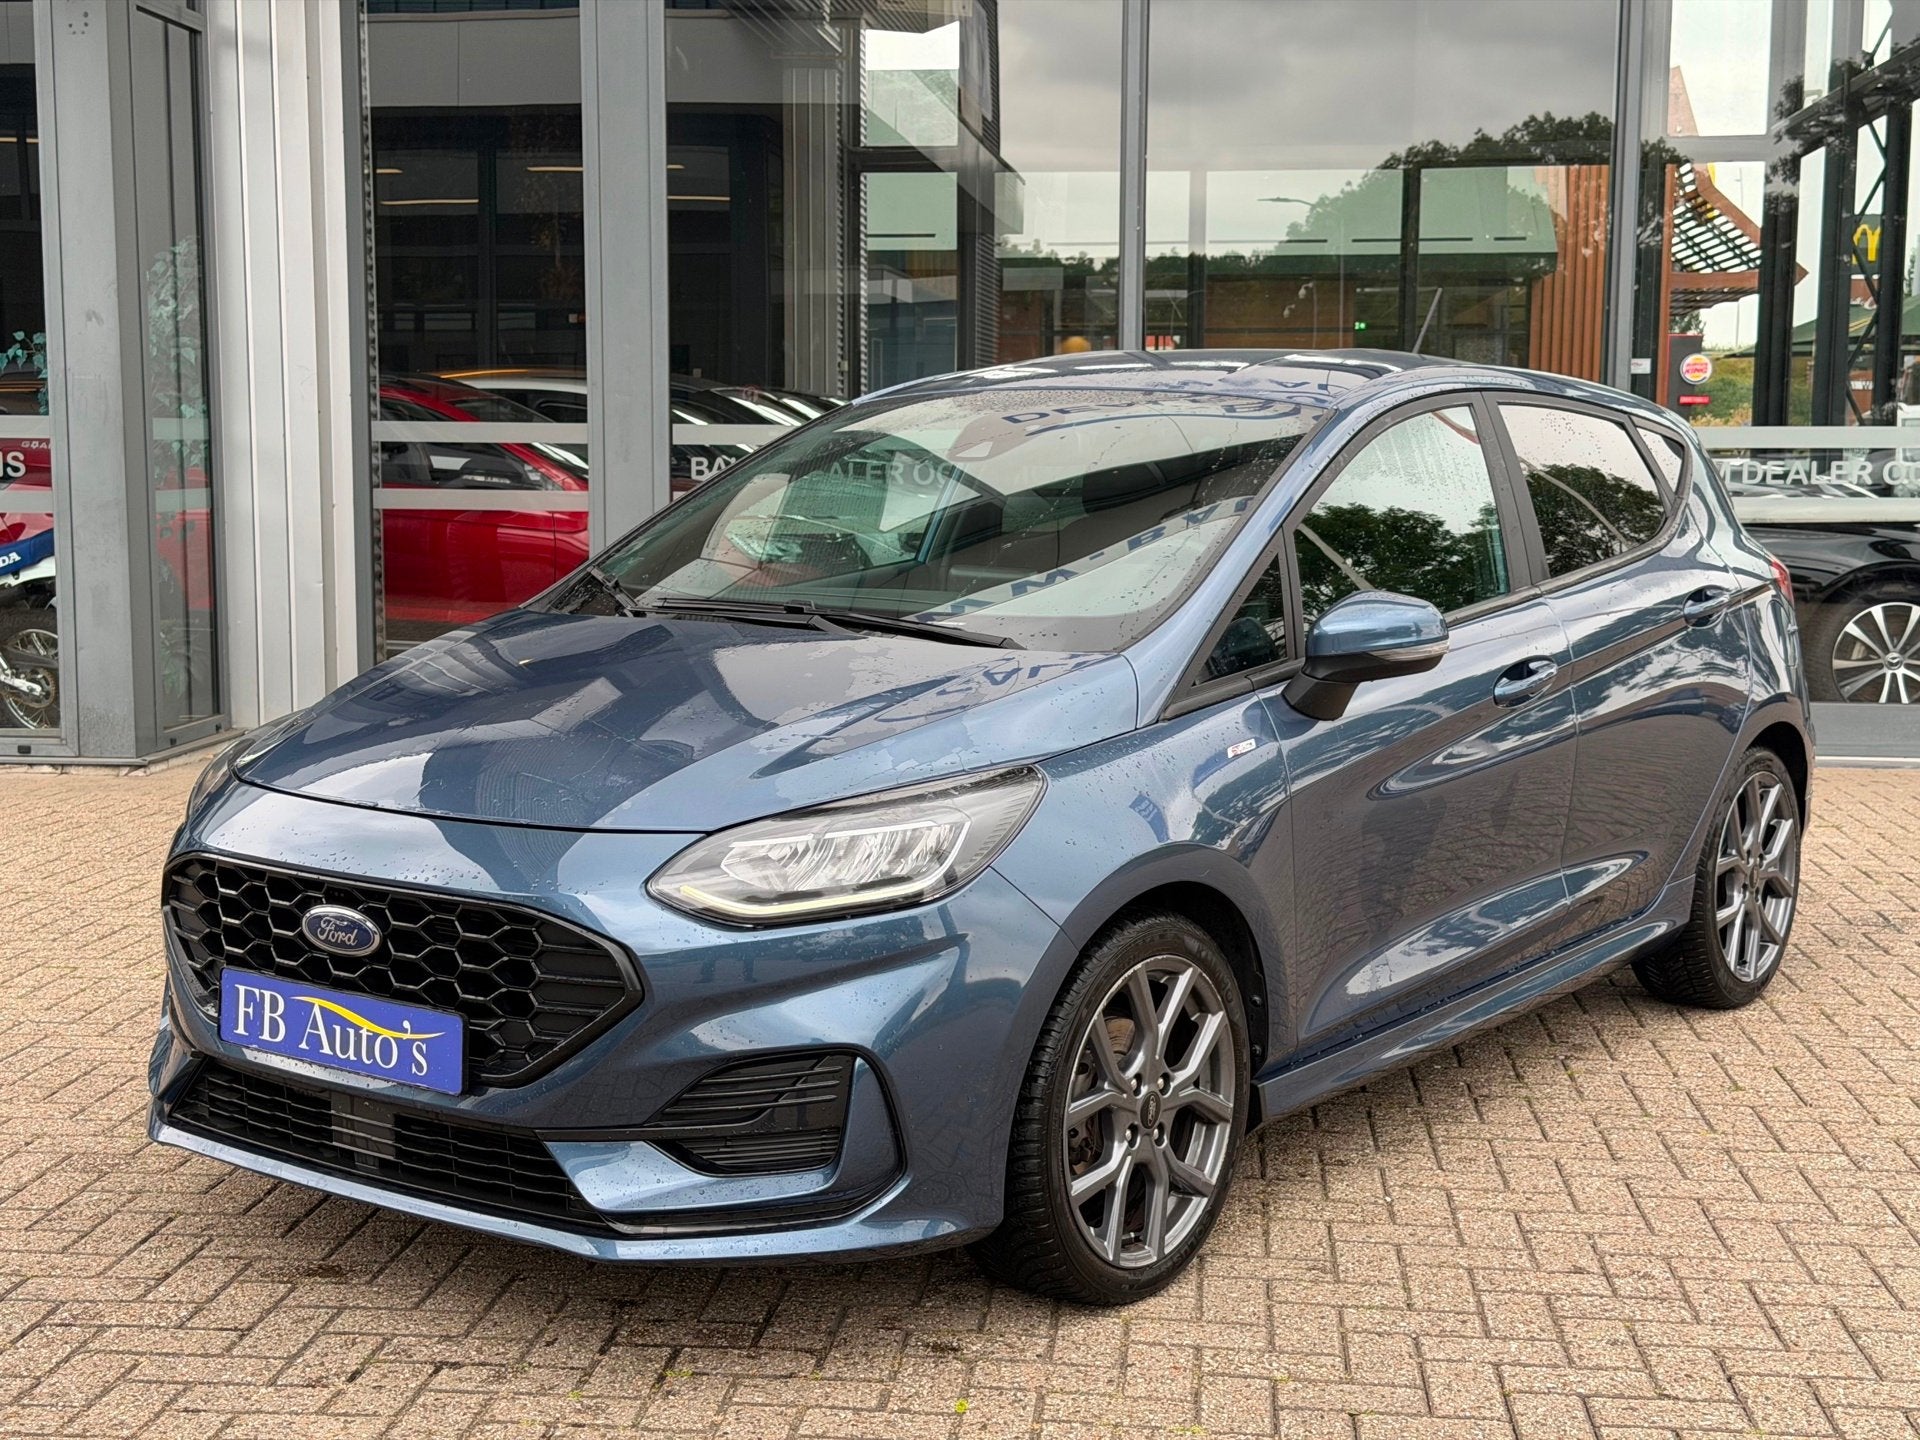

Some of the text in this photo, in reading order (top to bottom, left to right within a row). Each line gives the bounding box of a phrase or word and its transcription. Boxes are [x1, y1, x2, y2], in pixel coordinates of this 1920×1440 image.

[1742, 460, 1873, 485] DEALER
[317, 916, 358, 946] Ford
[233, 984, 428, 1076] FB Auto's
